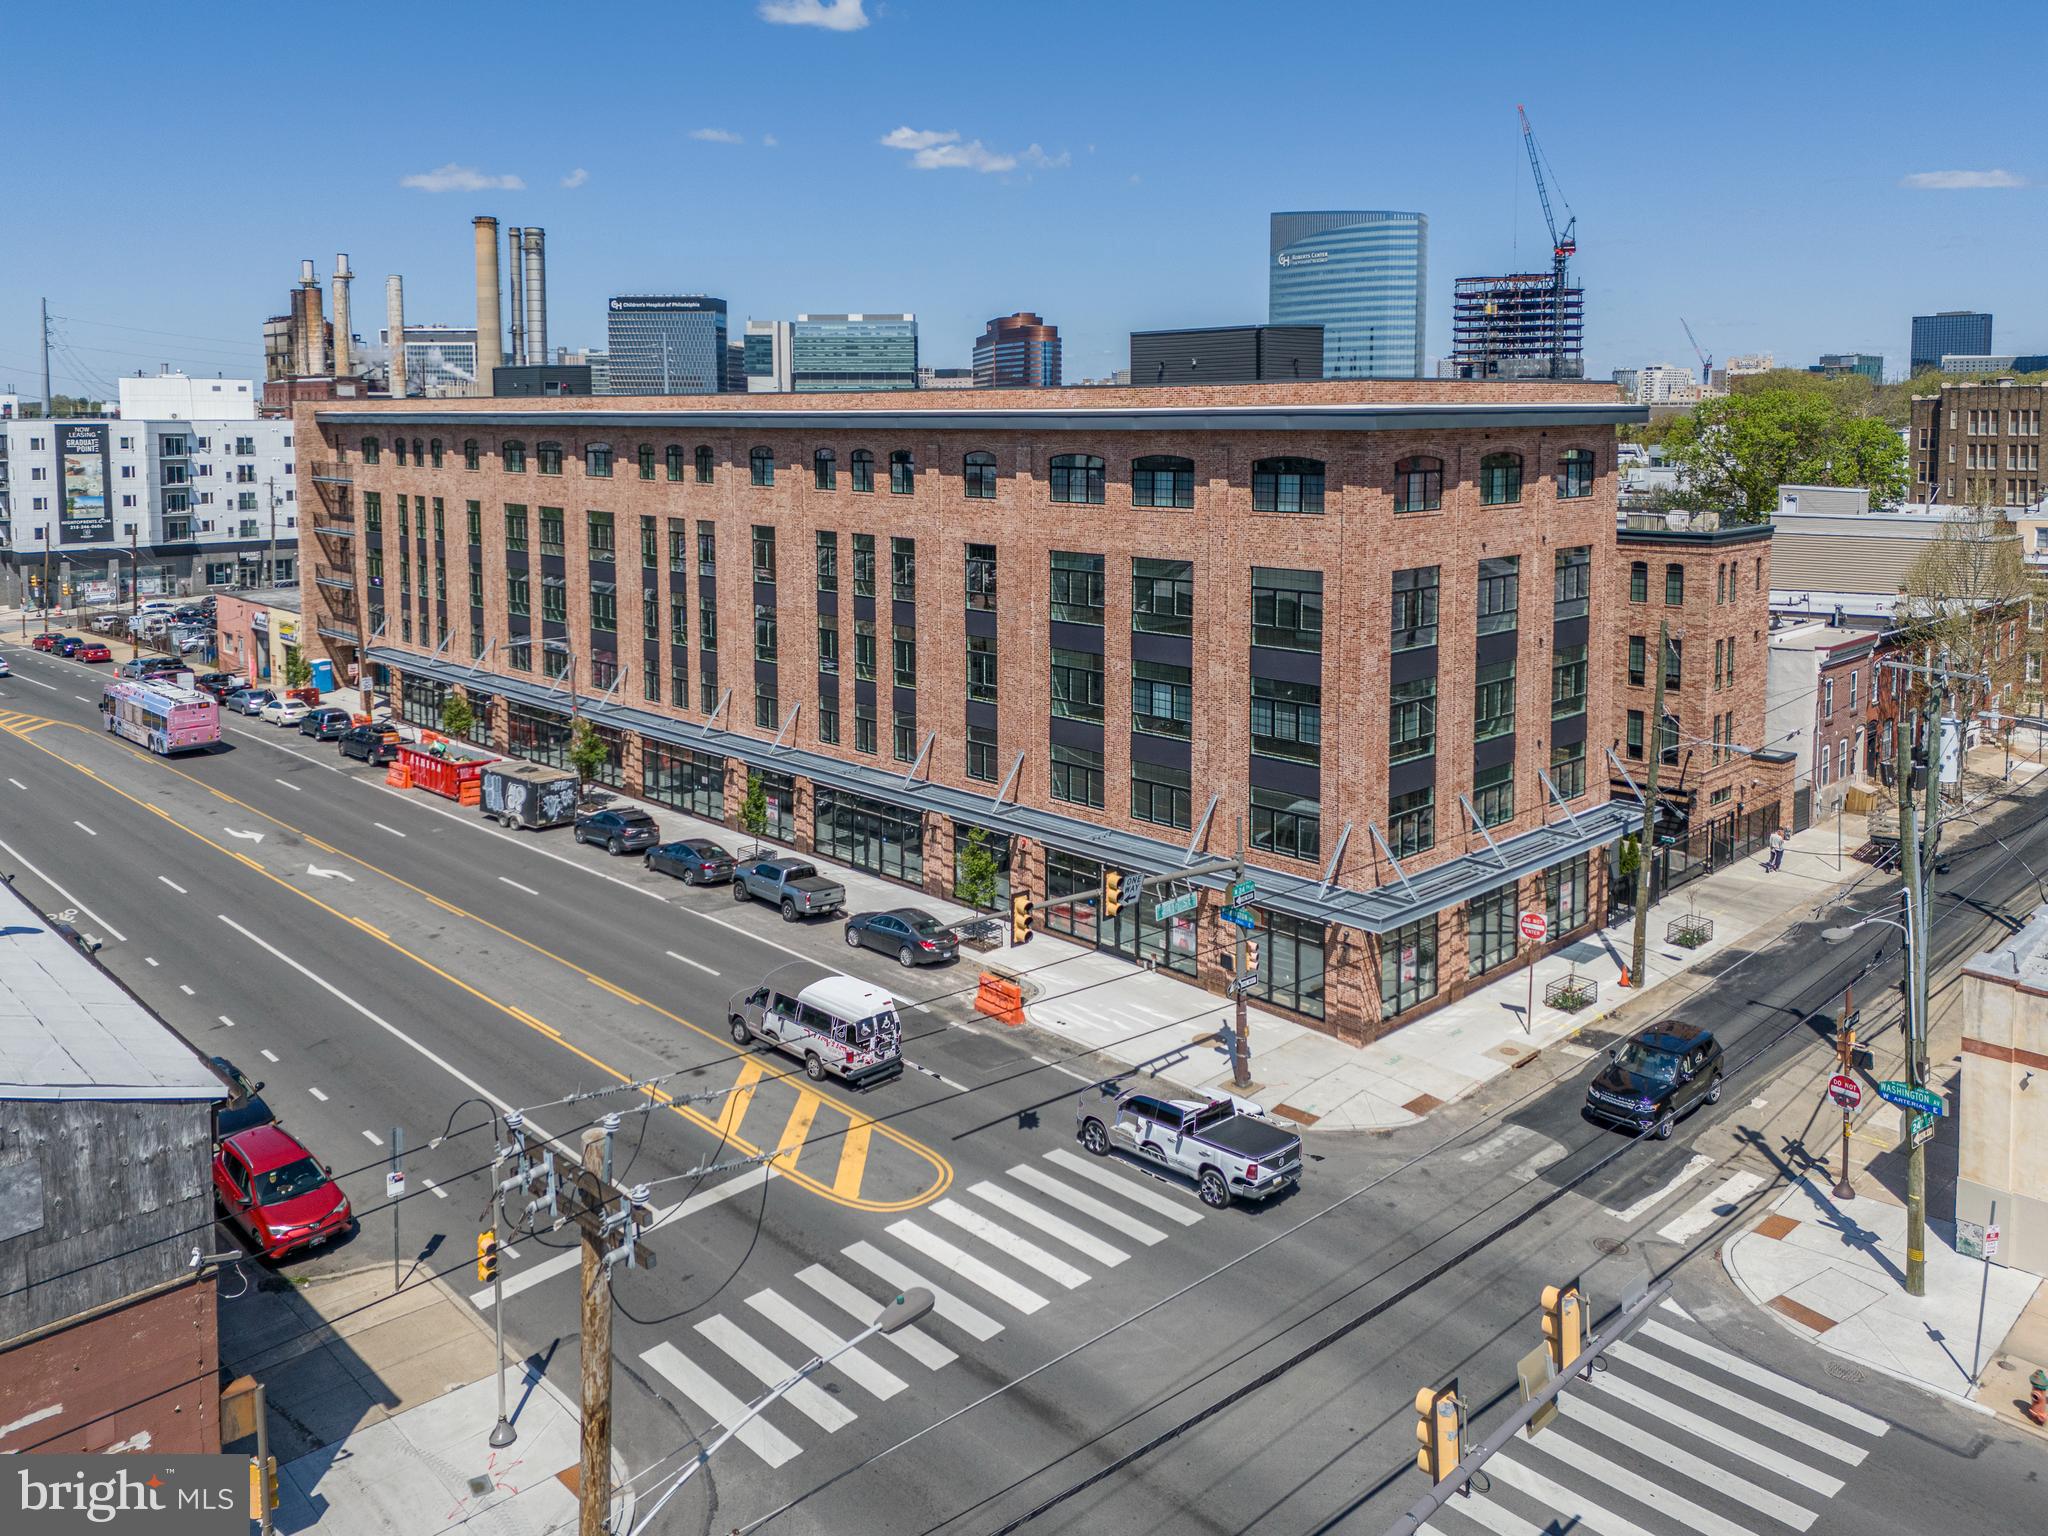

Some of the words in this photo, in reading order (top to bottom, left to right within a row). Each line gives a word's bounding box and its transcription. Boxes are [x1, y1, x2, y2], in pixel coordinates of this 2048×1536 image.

[1127, 875, 1141, 885] ONE
[1525, 928, 1540, 936] ENTER
[1844, 1083, 1857, 1091] NOT
[1880, 1082, 1930, 1103] WASHINGTON
[1893, 1096, 1928, 1111] ARTERIAL
